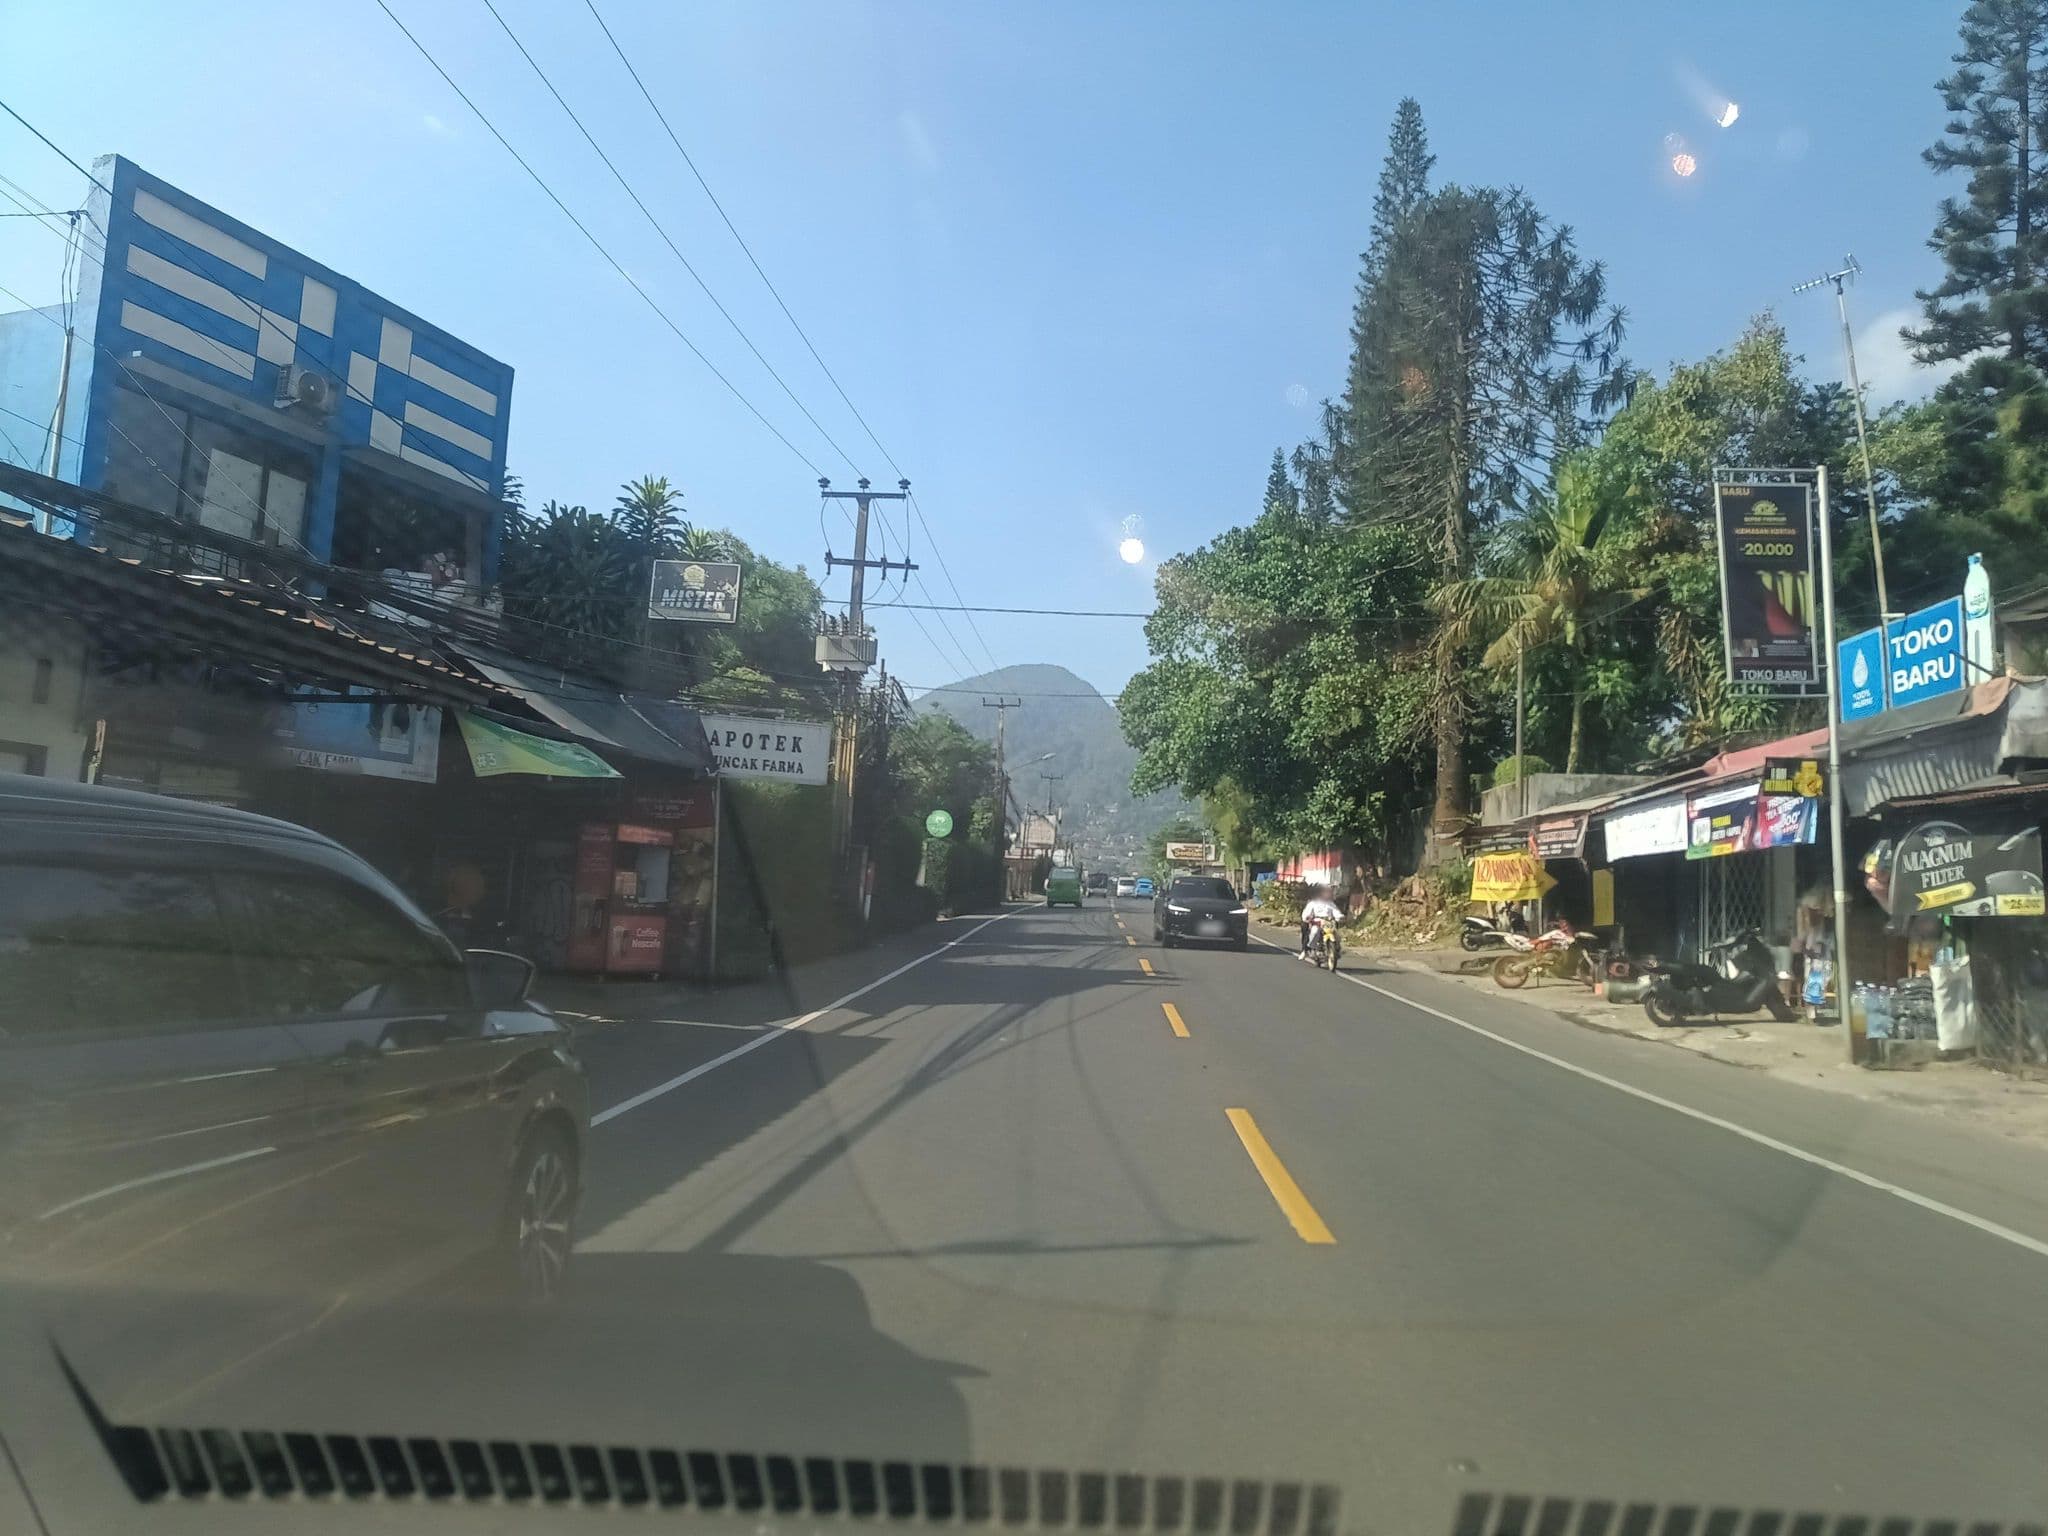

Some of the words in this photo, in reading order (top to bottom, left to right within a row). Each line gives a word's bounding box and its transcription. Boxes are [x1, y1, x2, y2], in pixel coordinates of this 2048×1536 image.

[660, 588, 727, 611] MISTER
[1891, 619, 1953, 658] TOKO
[1741, 669, 1774, 680] TOKO
[1775, 669, 1808, 681] BARU
[1893, 654, 1955, 694] BARU
[710, 730, 803, 753] APOTEK
[762, 759, 804, 774] FARMA
[1904, 841, 1973, 873] MAGNUM
[1922, 865, 1965, 887] FILTER
